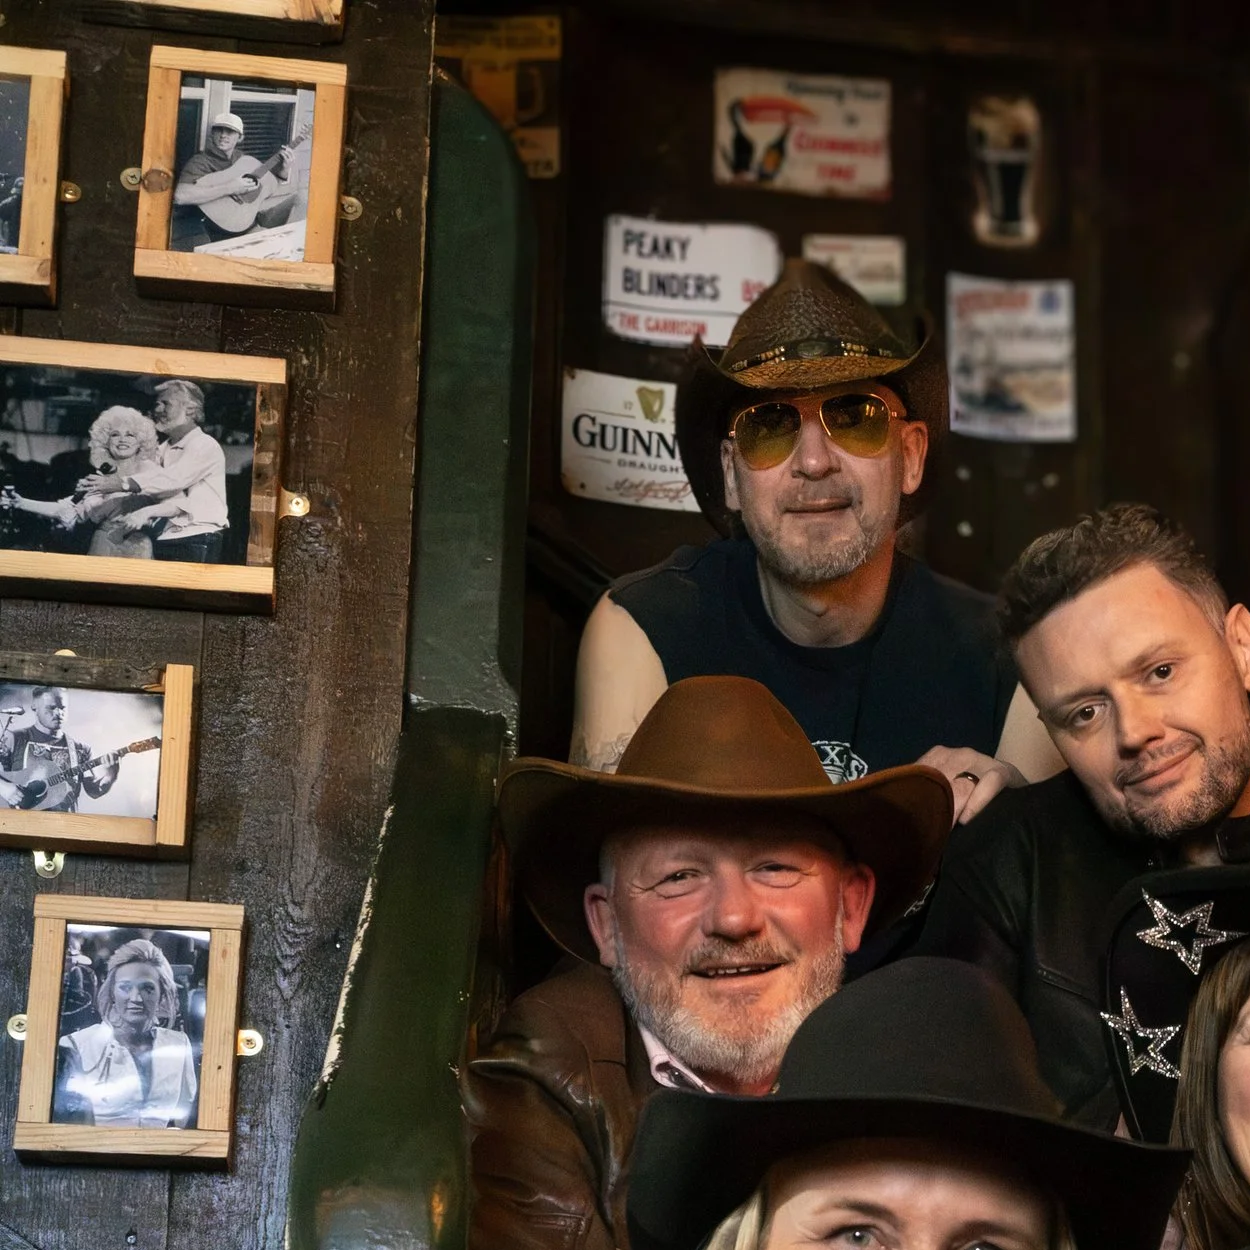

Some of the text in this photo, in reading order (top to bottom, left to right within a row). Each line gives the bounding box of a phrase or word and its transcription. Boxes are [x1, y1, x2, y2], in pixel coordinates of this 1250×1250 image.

[622, 229, 690, 262] PEAKY
[622, 267, 720, 301] BLINDERS
[619, 312, 639, 330] THE
[617, 459, 686, 474] DRAUGH
